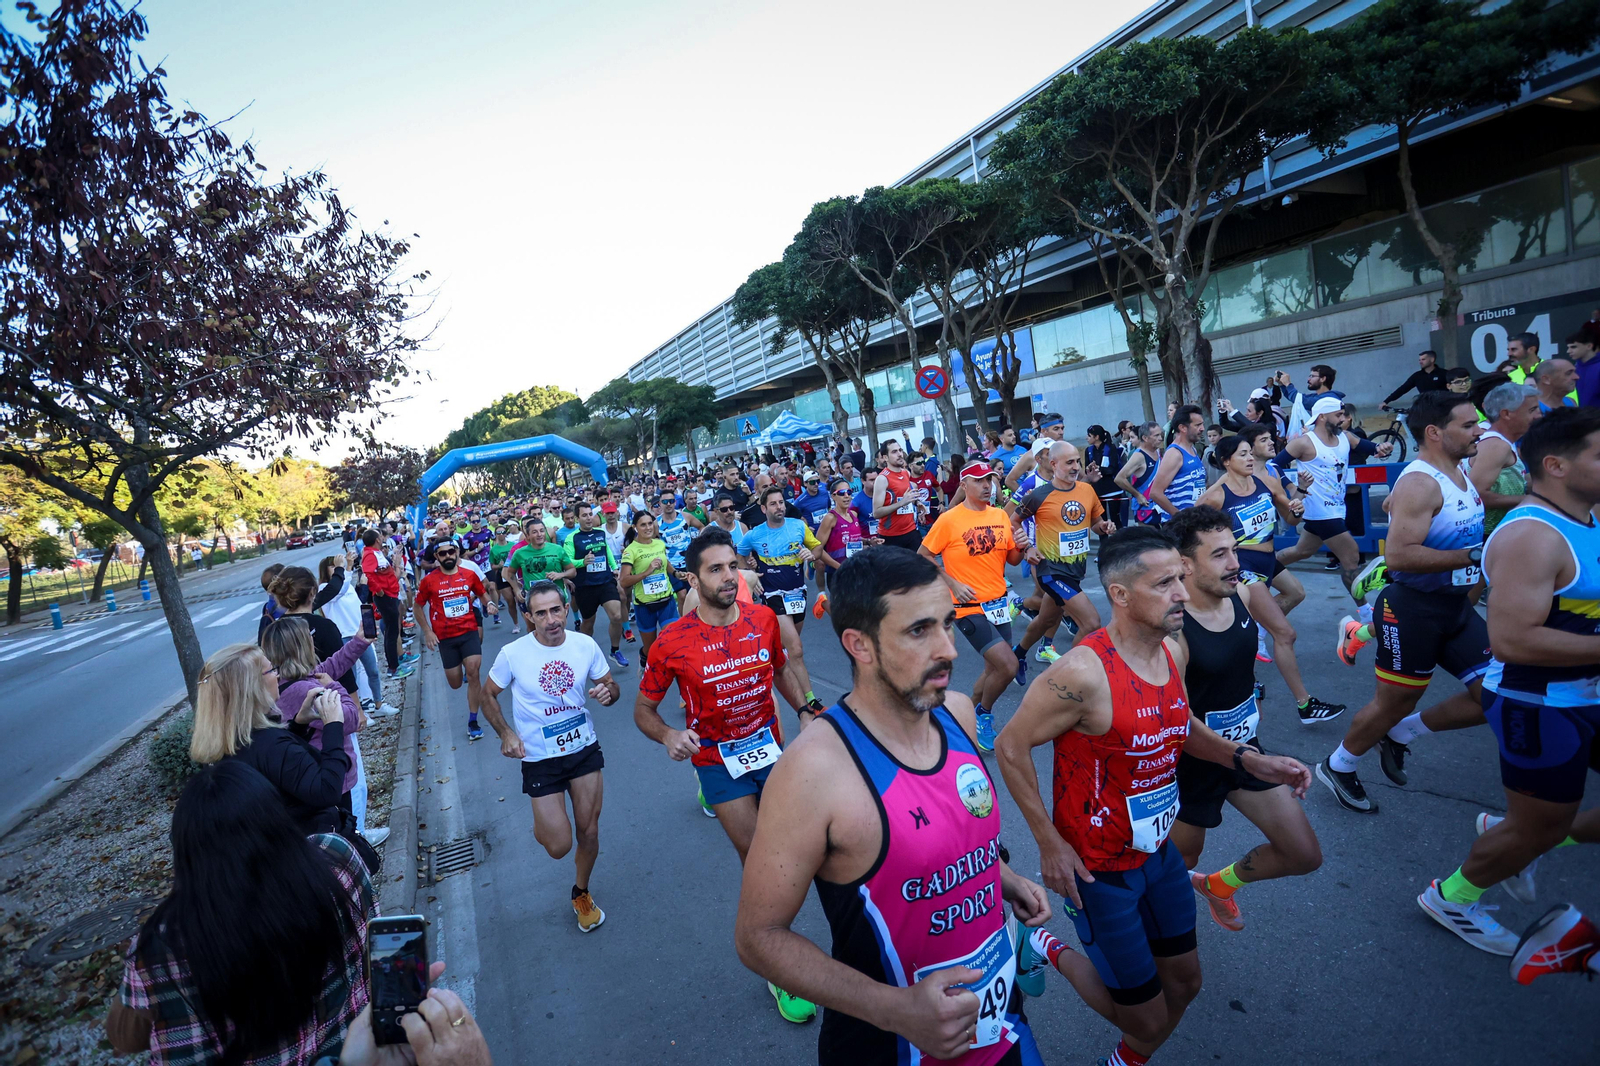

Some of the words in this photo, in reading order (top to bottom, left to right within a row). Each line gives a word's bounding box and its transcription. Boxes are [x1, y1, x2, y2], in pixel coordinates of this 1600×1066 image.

[1472, 307, 1516, 323] Tribuna
[1471, 313, 1559, 374] 04
[1251, 512, 1269, 527] 402
[1067, 539, 1084, 551] 923
[649, 582, 664, 591] 256
[450, 604, 465, 614] 386
[991, 608, 1005, 620] 140
[1382, 624, 1391, 650] SPORT
[1390, 626, 1402, 671] ENERGYUM
[703, 653, 759, 676] Movijerez
[717, 697, 732, 707] SG
[556, 728, 582, 747] 644
[1221, 720, 1250, 741] 525
[738, 747, 769, 766] 655
[1152, 804, 1176, 838] 109
[928, 881, 996, 937] SPORT
[962, 954, 986, 970] arrera
[985, 933, 1003, 956] Popular
[988, 951, 1001, 969] Jerez
[979, 976, 1008, 1021] 49
